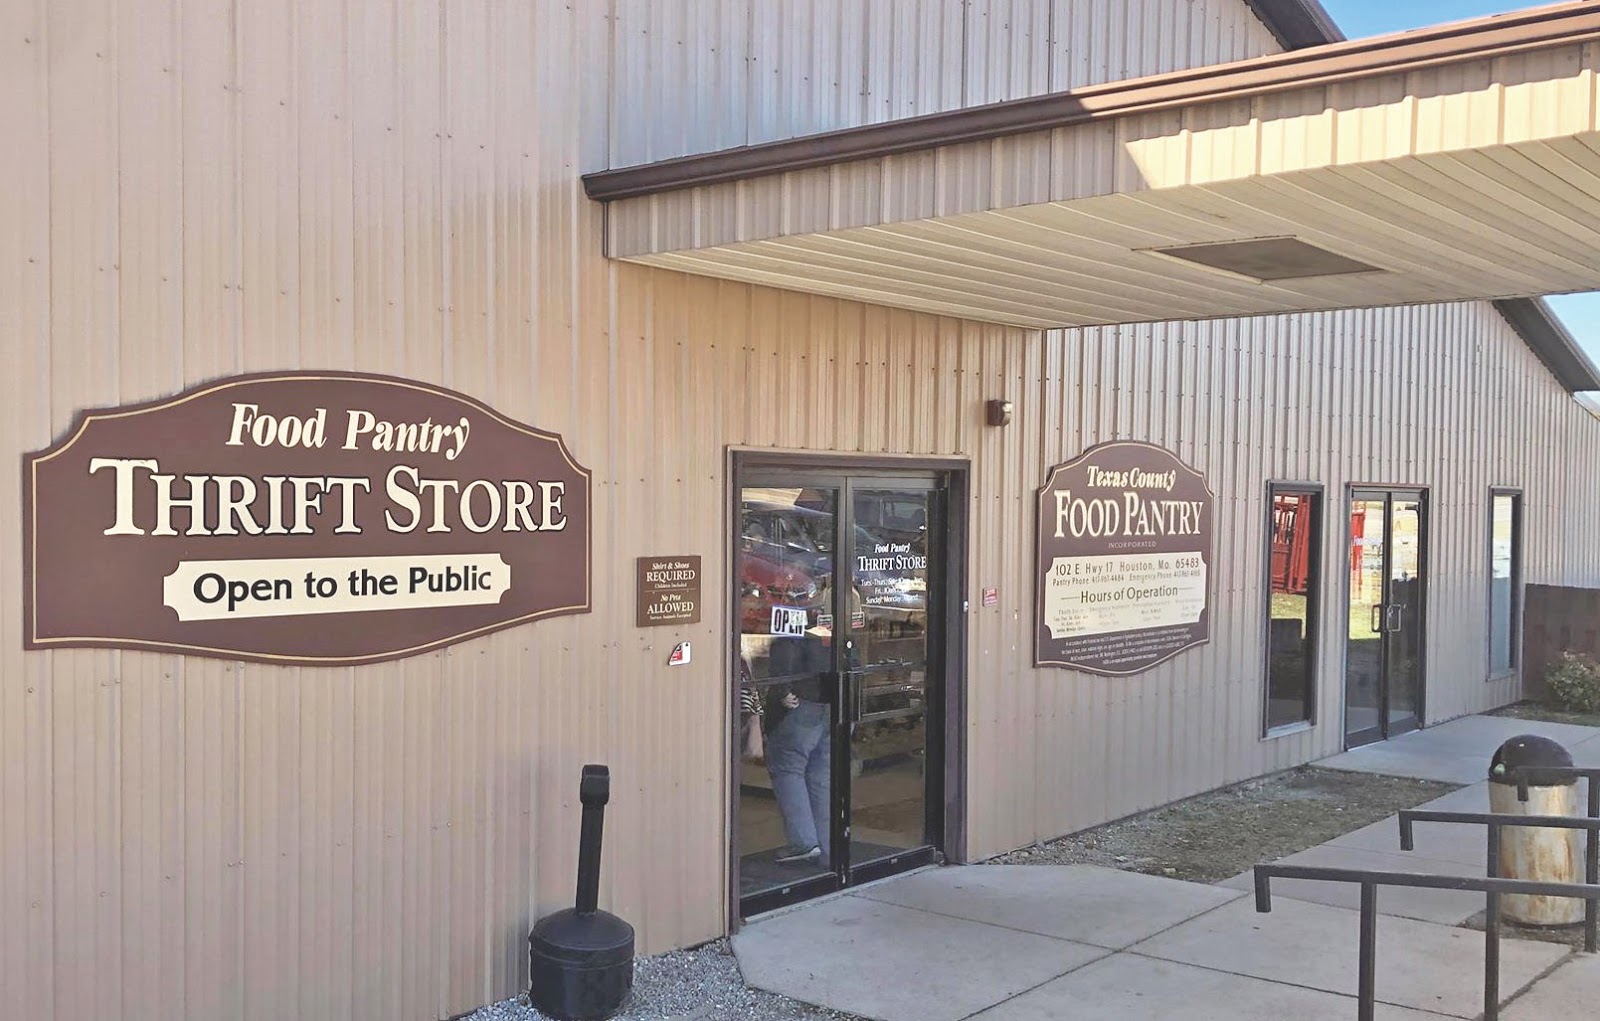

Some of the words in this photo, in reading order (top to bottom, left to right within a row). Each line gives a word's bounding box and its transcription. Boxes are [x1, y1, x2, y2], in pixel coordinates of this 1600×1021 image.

[225, 402, 327, 448] Food
[342, 409, 470, 460] Pantry
[1087, 465, 1128, 488] Texas
[1129, 467, 1176, 492] County
[90, 458, 371, 537] THRIFT
[384, 465, 567, 534] STORE
[1054, 490, 1120, 538] FOOD
[1123, 491, 1204, 536] PANTRY
[874, 543, 889, 553] Food
[890, 543, 911, 553] Pantry
[1108, 541, 1157, 549] INCORPORATED
[857, 556, 895, 571] THRIFT
[896, 554, 927, 570] STORE
[1055, 563, 1071, 576] 102
[1085, 562, 1103, 575] Hwy
[1106, 561, 1113, 573] 17
[1175, 558, 1199, 569] 65483
[646, 570, 696, 582] REQUIRED
[1053, 578, 1070, 586] Pantry
[1072, 577, 1089, 585] Phone
[193, 572, 292, 611] Open
[304, 573, 338, 598] to
[348, 569, 398, 596] the
[409, 566, 492, 594] Public
[1081, 590, 1112, 603] Hours
[1114, 587, 1125, 601] of
[1126, 586, 1178, 601] Operation
[660, 594, 669, 602] No
[669, 593, 681, 601] Pets
[647, 601, 694, 614] ALLOWED
